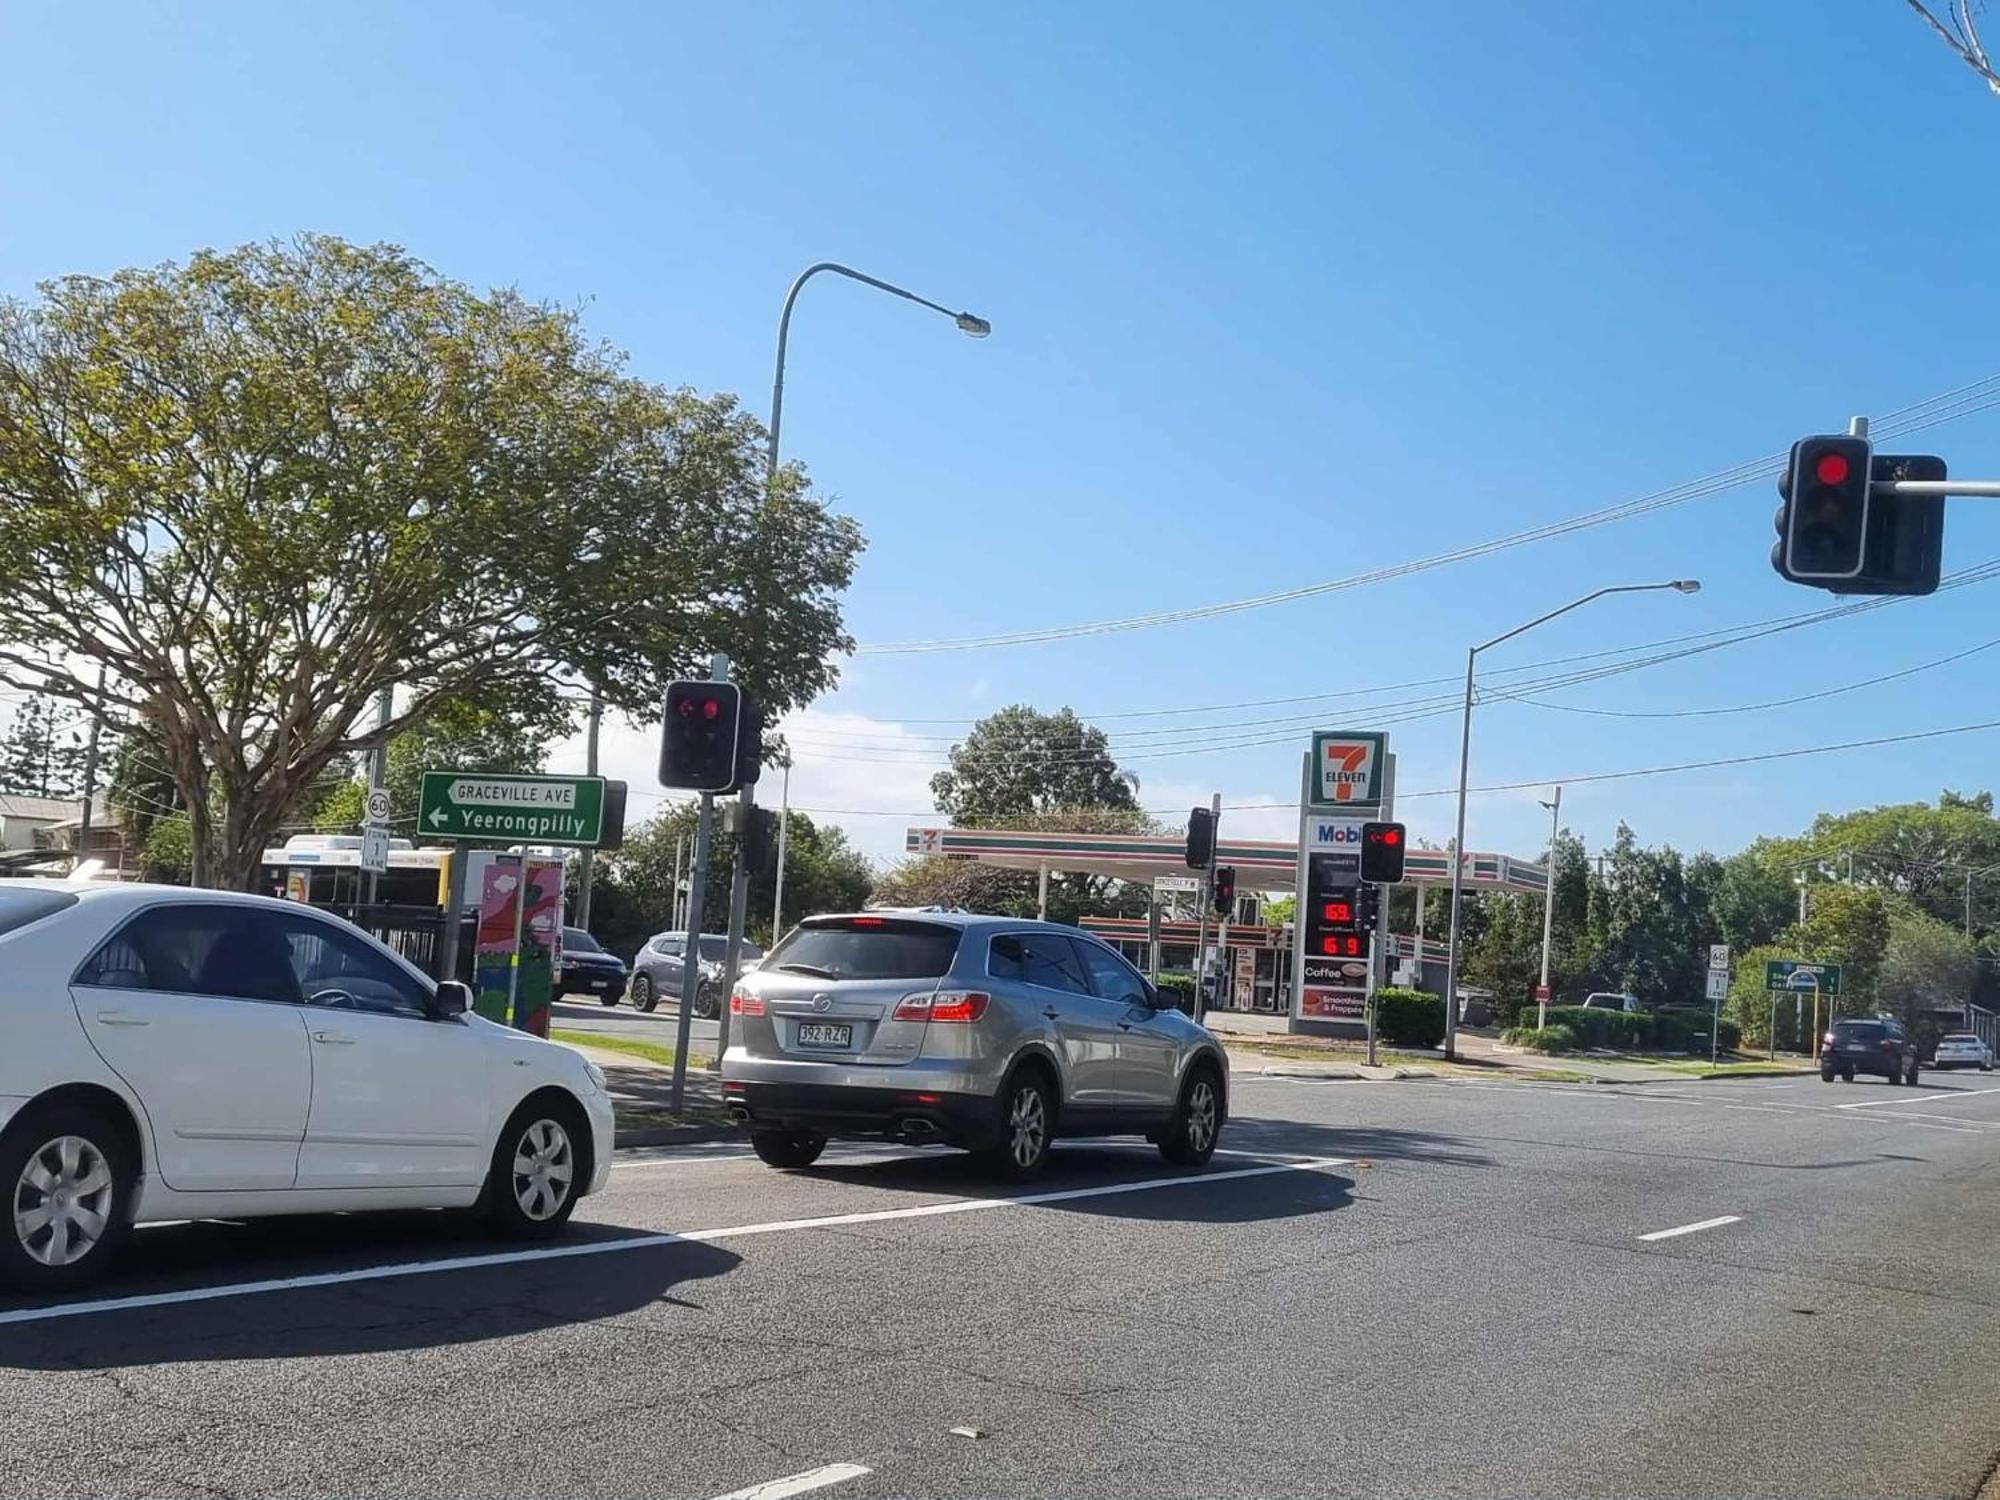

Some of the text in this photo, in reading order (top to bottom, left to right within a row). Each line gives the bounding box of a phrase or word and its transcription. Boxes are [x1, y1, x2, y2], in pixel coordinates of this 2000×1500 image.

[1328, 745, 1367, 801] 7
[458, 784, 572, 803] GRACEVILLE AVE
[371, 799, 387, 812] 60
[461, 809, 585, 837] Yeerongpilly
[1712, 952, 1726, 961] 60
[1305, 967, 1342, 978] Coffee
